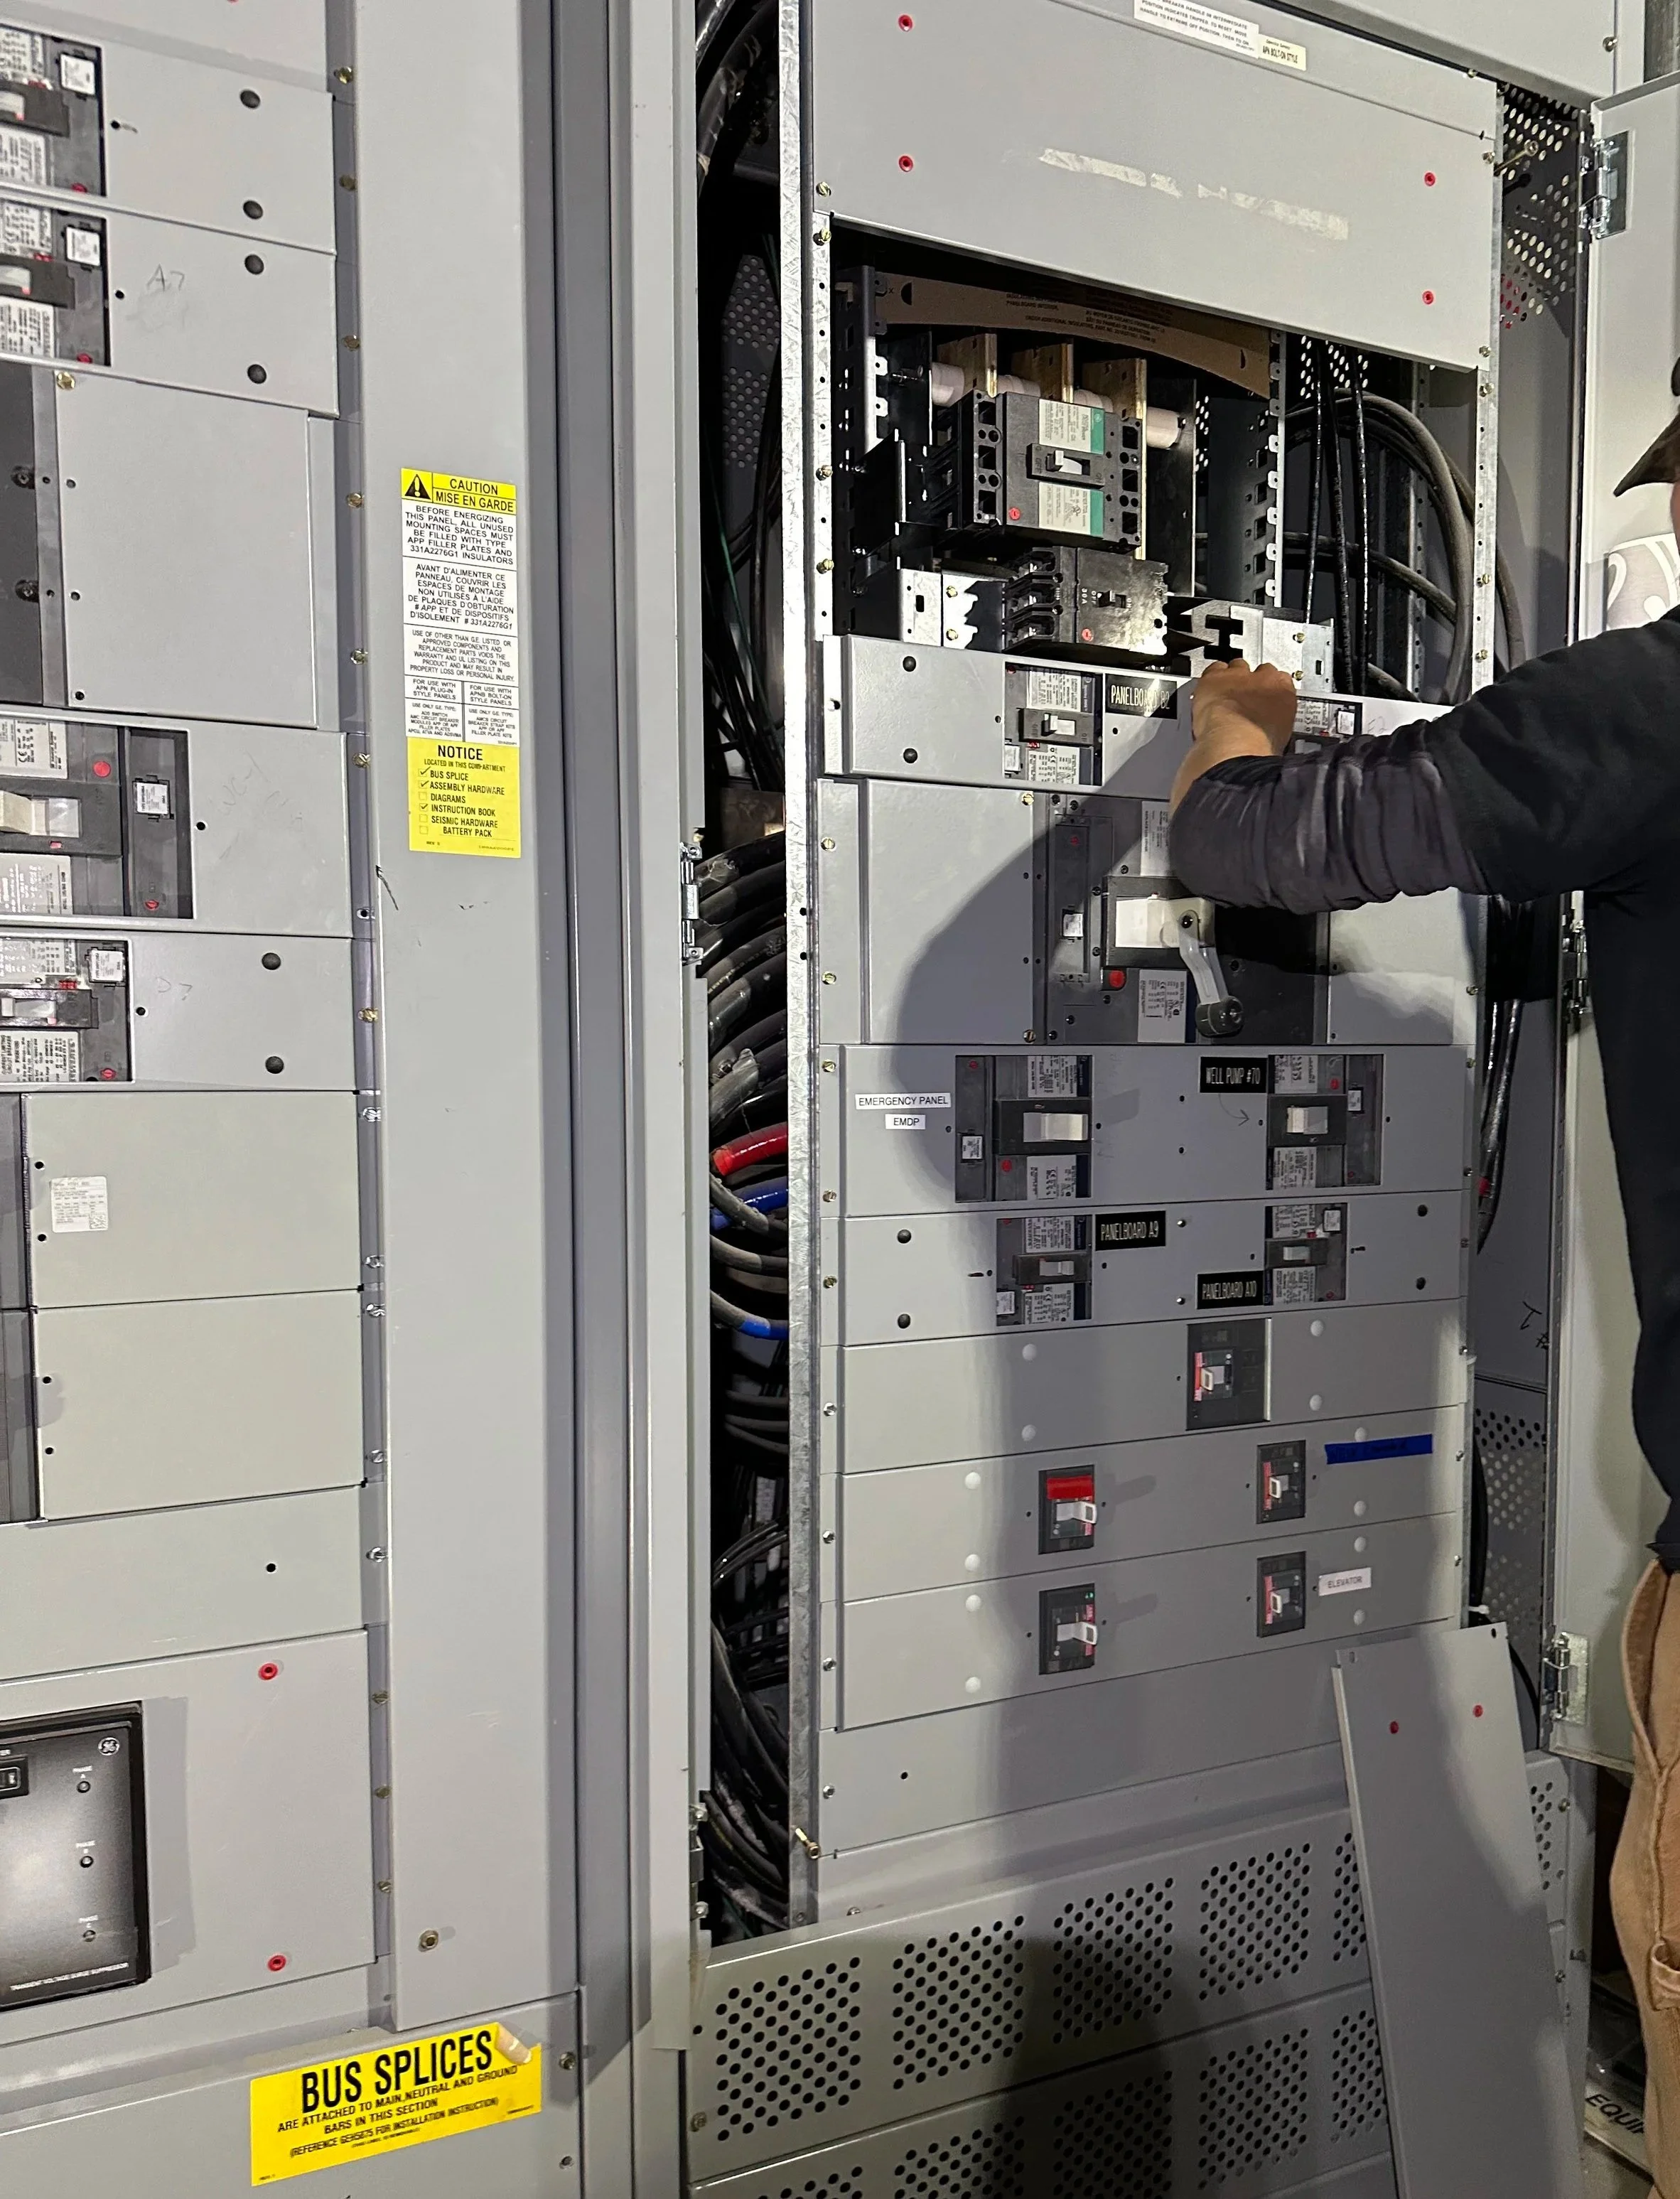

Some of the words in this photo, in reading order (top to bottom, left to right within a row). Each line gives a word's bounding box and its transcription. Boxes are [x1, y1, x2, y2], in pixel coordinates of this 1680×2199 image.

[449, 478, 498, 495] CAUTION
[435, 490, 460, 505] MISE
[462, 494, 475, 507] EN
[478, 496, 513, 512] GARDE
[415, 504, 449, 517] BEFORE
[453, 510, 503, 524] ENERGIZING
[404, 511, 424, 521] THIS
[460, 519, 476, 528] ALL
[479, 522, 514, 533] UNUSED
[405, 519, 451, 532] MOUNTING
[453, 526, 487, 537] SPACES
[490, 531, 513, 541] MUST
[413, 528, 425, 537] BE
[429, 530, 458, 542] FILLED
[460, 535, 482, 544] WITH
[485, 538, 506, 549] TYPE
[406, 536, 424, 544] APP
[428, 538, 456, 549] FILLER
[460, 543, 492, 554] PLATES
[494, 548, 512, 557] AND
[462, 552, 513, 565] INSULATORS
[415, 563, 441, 572] AVANT
[443, 566, 492, 580] D'ALIMENTER
[495, 573, 505, 581] CE
[416, 579, 452, 591] ESPACES
[454, 584, 465, 592] DE
[468, 585, 504, 597] MONTAGE
[455, 576, 489, 587] COUVRIR
[492, 581, 506, 589] LES
[407, 593, 418, 602] DE
[421, 596, 457, 607] PLAQUES
[417, 587, 435, 596] NON
[480, 595, 503, 605] L'AIDE
[1126, 598, 1132, 609] ON
[409, 610, 460, 623] D'ISOLEMENT
[420, 603, 437, 612] APP
[451, 607, 462, 615] DE
[464, 608, 509, 621] DISPOSITIFS
[421, 637, 451, 647] APPROVED
[452, 640, 489, 651] COMPONENTS
[434, 631, 453, 640] OTHER
[453, 633, 469, 642] THAN
[481, 637, 500, 645] LISTED
[413, 650, 443, 660] WARRANTY
[467, 657, 488, 665] LISTING
[417, 643, 457, 654] REPLACEMENT
[458, 648, 476, 657] PARTS
[409, 663, 438, 673] PROPERTY
[465, 670, 494, 679] PERSONAL
[421, 658, 448, 667] PRODUCT
[475, 664, 495, 672] RESULT
[412, 689, 431, 698] STYLE
[433, 692, 456, 700] PANELS
[489, 698, 512, 706] PANELS
[1111, 684, 1157, 709] PANELBOARD
[437, 744, 483, 760] NOTICE
[424, 758, 447, 767] LOCATED
[454, 760, 467, 769] THIS
[429, 769, 444, 779] BUS
[445, 770, 469, 781] SPLICE
[429, 780, 465, 792] ASSEMBLY
[467, 784, 505, 795] HARDWARE
[430, 792, 466, 804] DIAGRAMS
[431, 803, 476, 815] INSTRUCTION
[478, 807, 496, 817] BOOK
[431, 814, 458, 825] SEISMIC
[460, 817, 497, 829] HARDWARE
[442, 825, 473, 836] BATTERY
[474, 828, 492, 837] PACK
[1206, 1068, 1224, 1085] WELL
[1226, 1067, 1244, 1084] PUMP
[858, 1097, 917, 1106] EMERGENCY
[919, 1096, 949, 1105] PANEL
[893, 1117, 920, 1127] EMDP
[1101, 1222, 1146, 1241] PANELBOARD
[1148, 1221, 1159, 1237] A9
[1202, 1281, 1244, 1300] PANELBOARD
[1328, 1576, 1362, 1588] ELEVATOR
[301, 2060, 362, 2114] BUS
[374, 2029, 492, 2095] SPLICES
[277, 2118, 298, 2132] ARE
[301, 2104, 355, 2127] ATTACHED
[358, 2100, 372, 2112] TO
[452, 2075, 473, 2089] AND
[476, 2062, 517, 2083] GROUND
[323, 2119, 352, 2134] BARS
[355, 2115, 366, 2127] IN
[369, 2108, 393, 2122] THIS
[395, 2097, 438, 2116] SECTION
[375, 2123, 391, 2135] FOR
[392, 2109, 446, 2131] INSTALLATION
